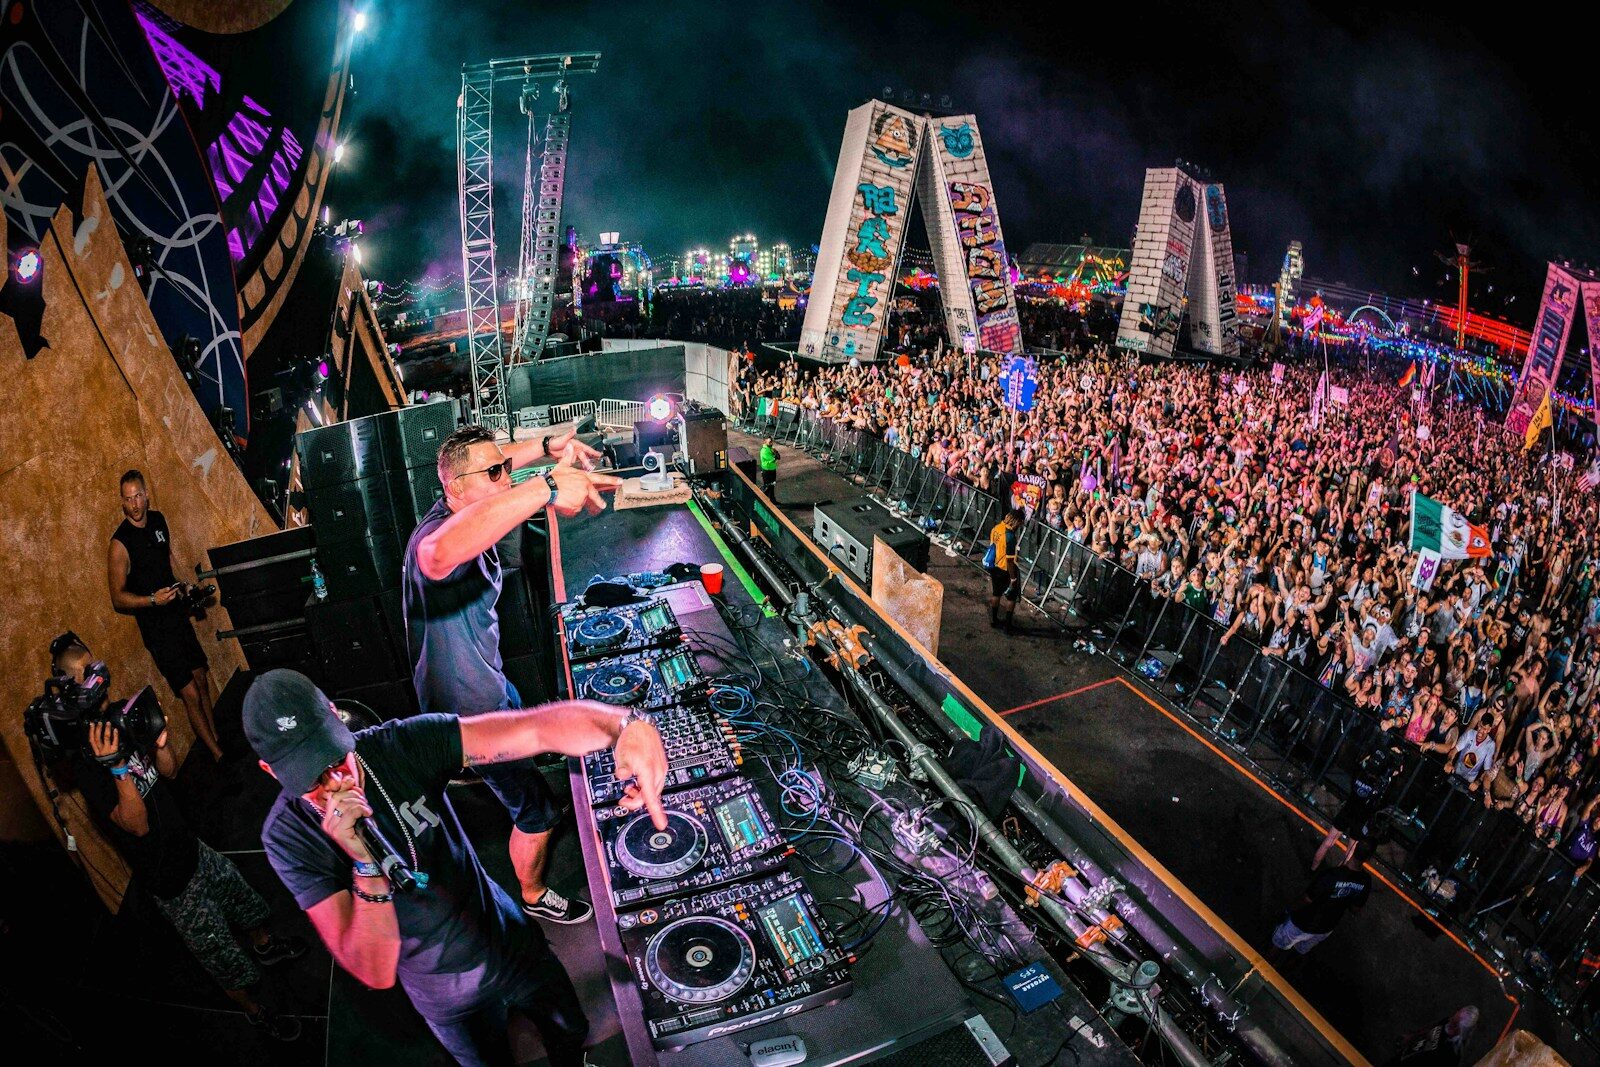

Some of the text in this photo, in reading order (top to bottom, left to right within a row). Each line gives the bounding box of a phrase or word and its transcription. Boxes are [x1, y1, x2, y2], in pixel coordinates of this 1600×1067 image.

[634, 956, 646, 982] Pioneer
[707, 1003, 804, 1037] Pioneer DJ
